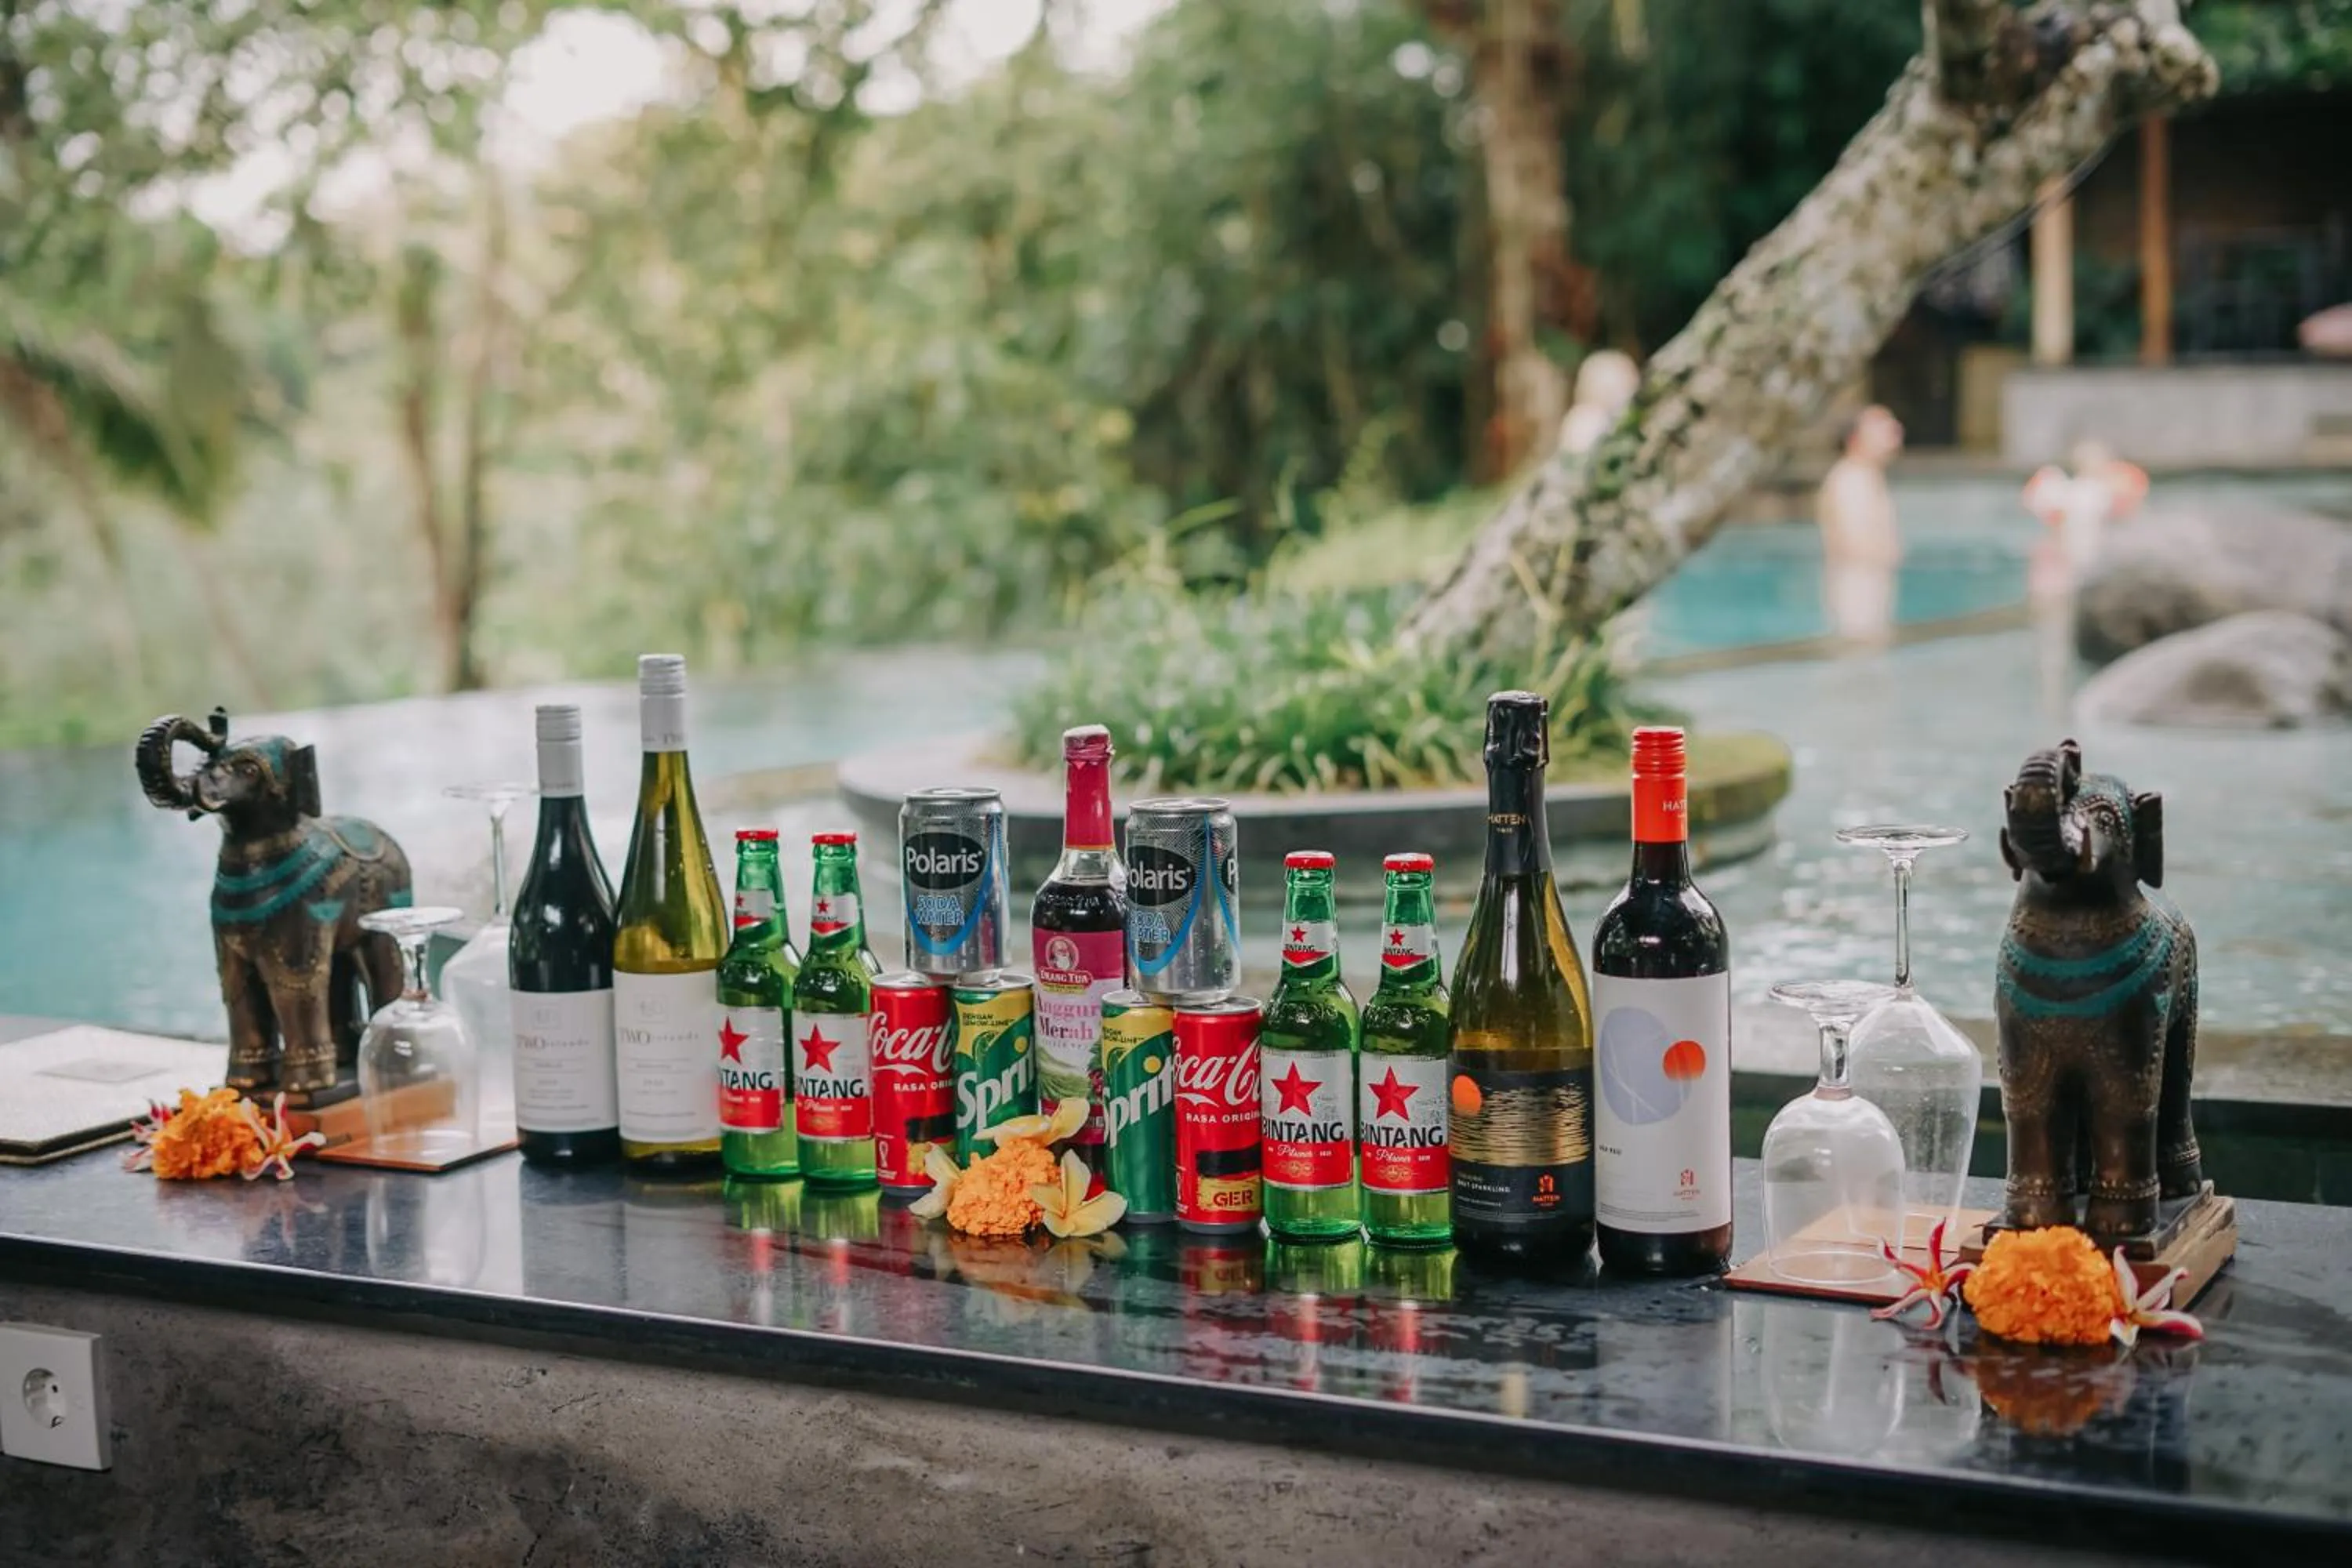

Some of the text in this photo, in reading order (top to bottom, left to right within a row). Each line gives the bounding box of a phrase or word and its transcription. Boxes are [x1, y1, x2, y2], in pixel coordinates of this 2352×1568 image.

[1663, 800, 1686, 812] HAT
[906, 846, 980, 874] Polaris
[1130, 861, 1188, 891] olaris
[916, 895, 960, 911] SODA
[1069, 973, 1088, 984] TUA
[1040, 1015, 1093, 1040] Merah
[1186, 1112, 1218, 1123] RASA
[1213, 1189, 1254, 1207] GER
